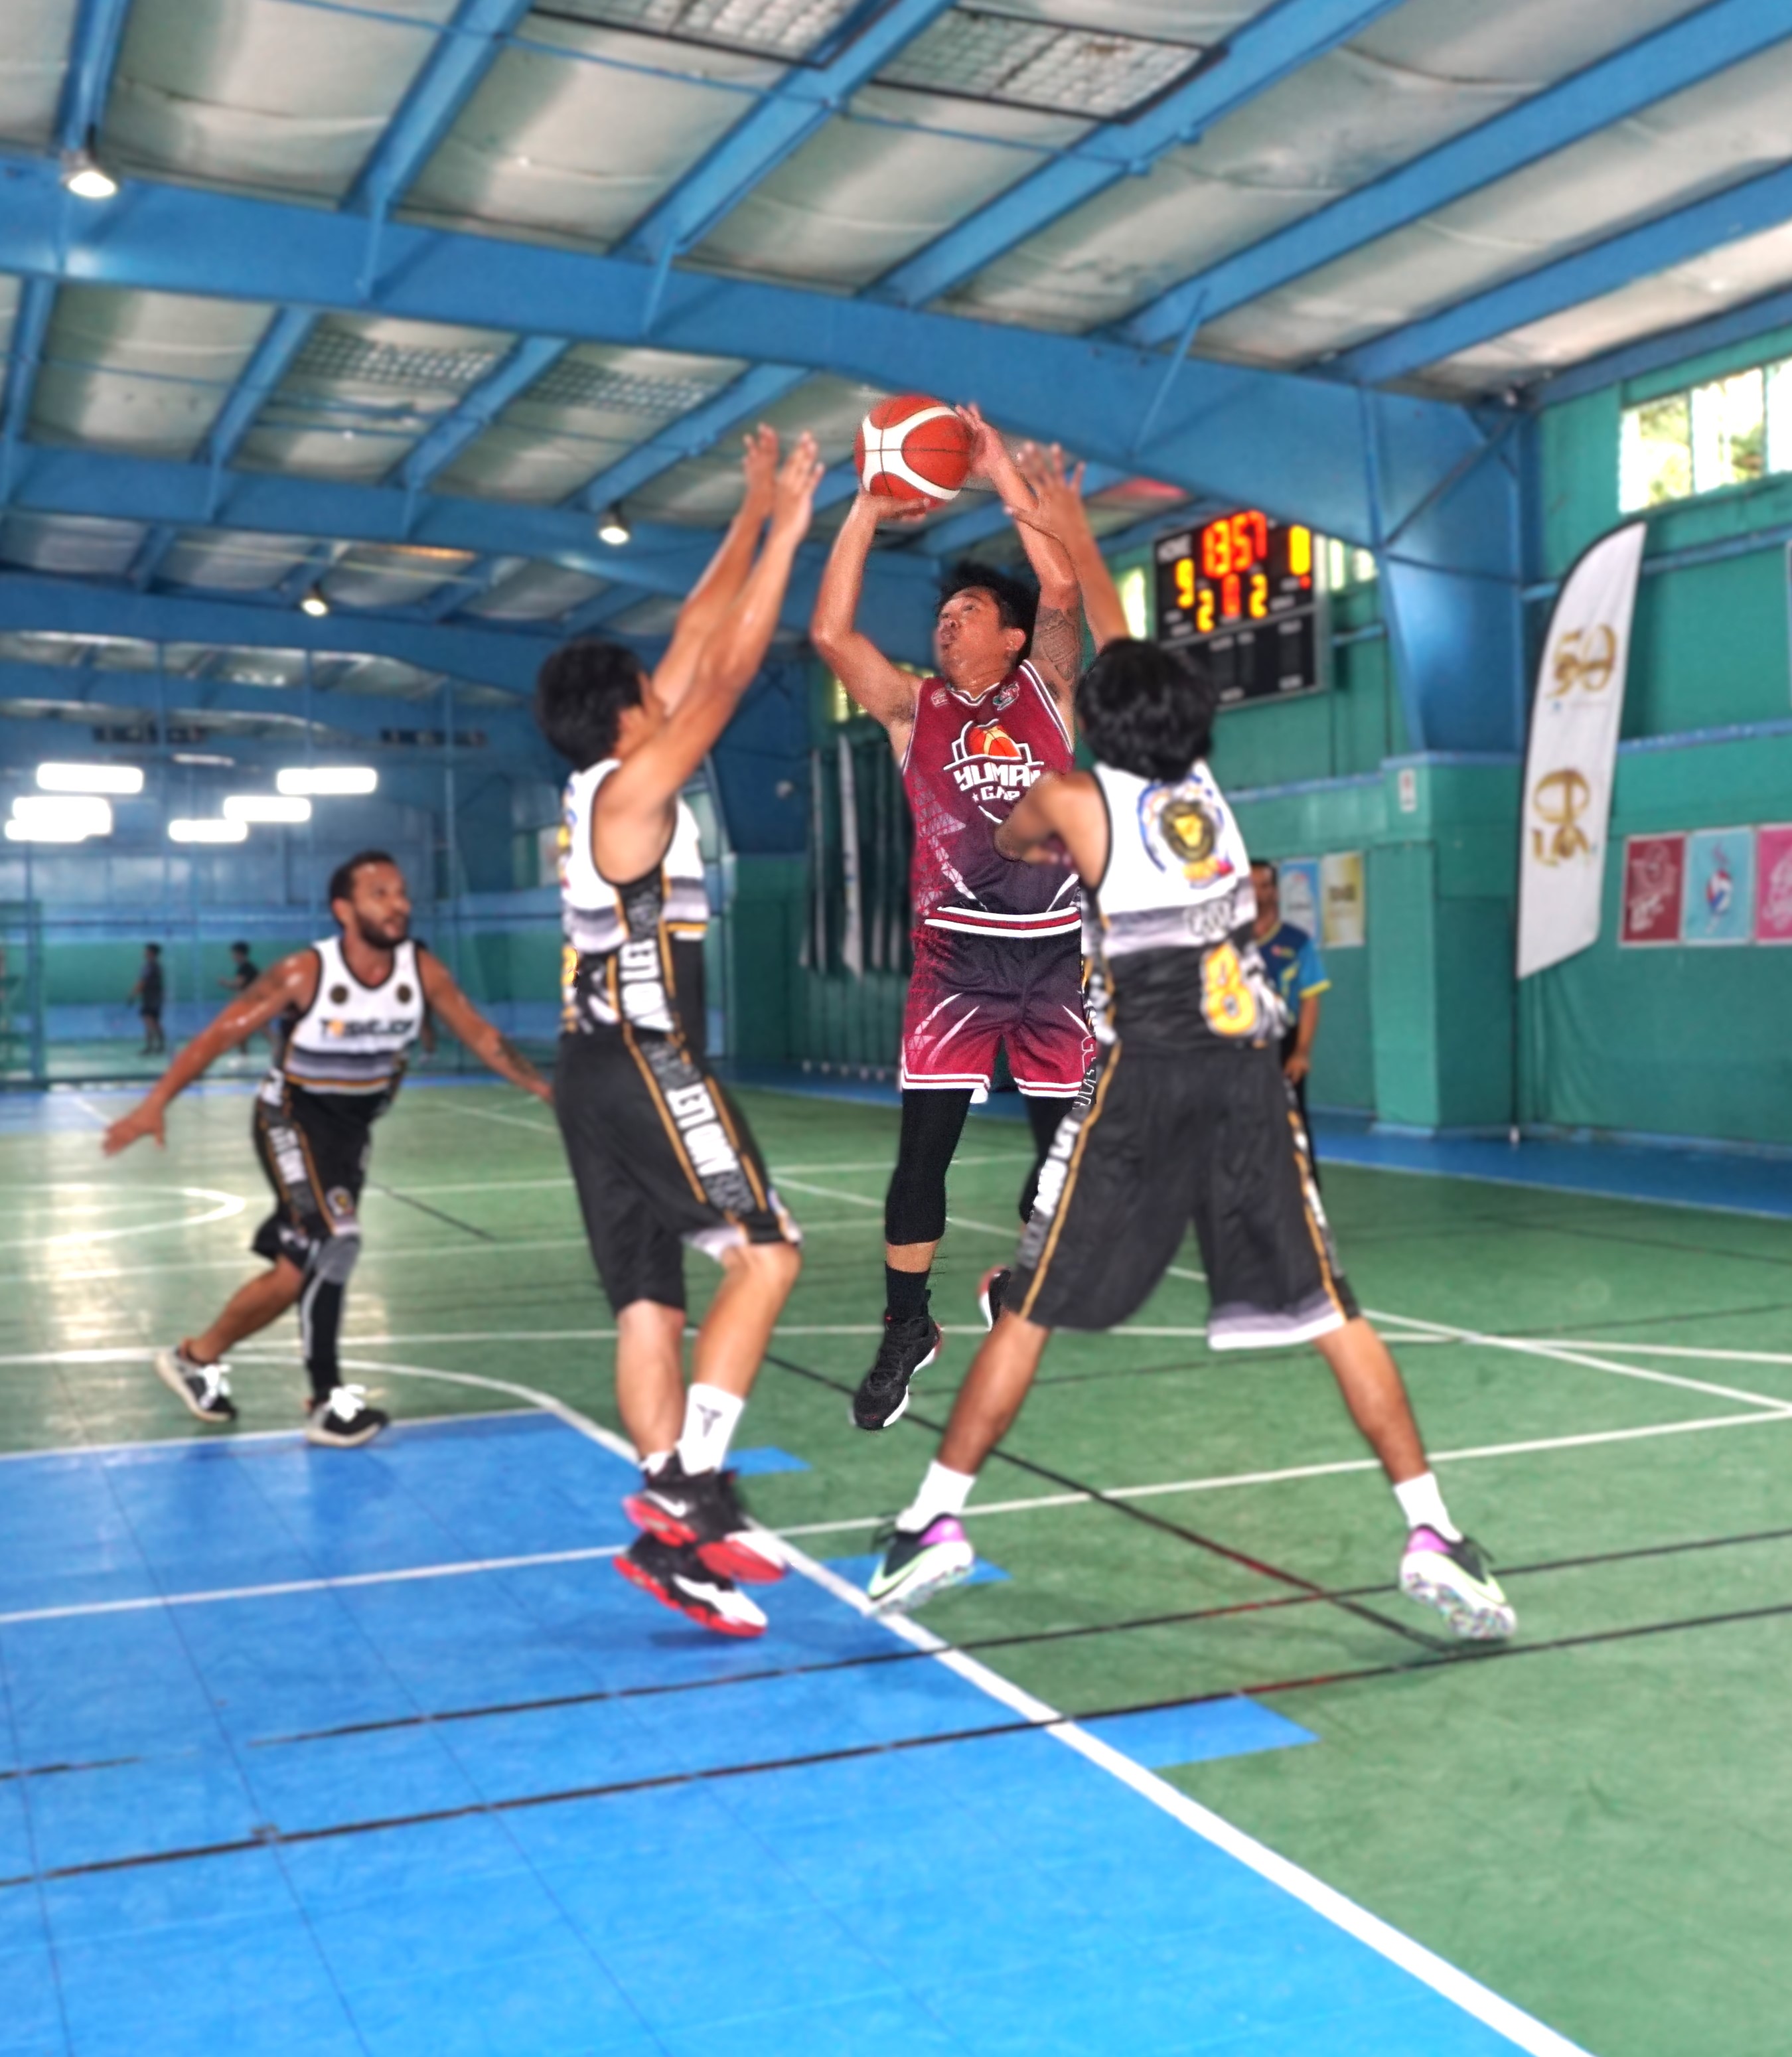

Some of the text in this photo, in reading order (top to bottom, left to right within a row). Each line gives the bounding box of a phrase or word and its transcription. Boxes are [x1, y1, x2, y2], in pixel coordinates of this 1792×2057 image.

[1176, 558, 1193, 607] 9
[1250, 573, 1267, 617] 2
[1197, 589, 1214, 632] 2
